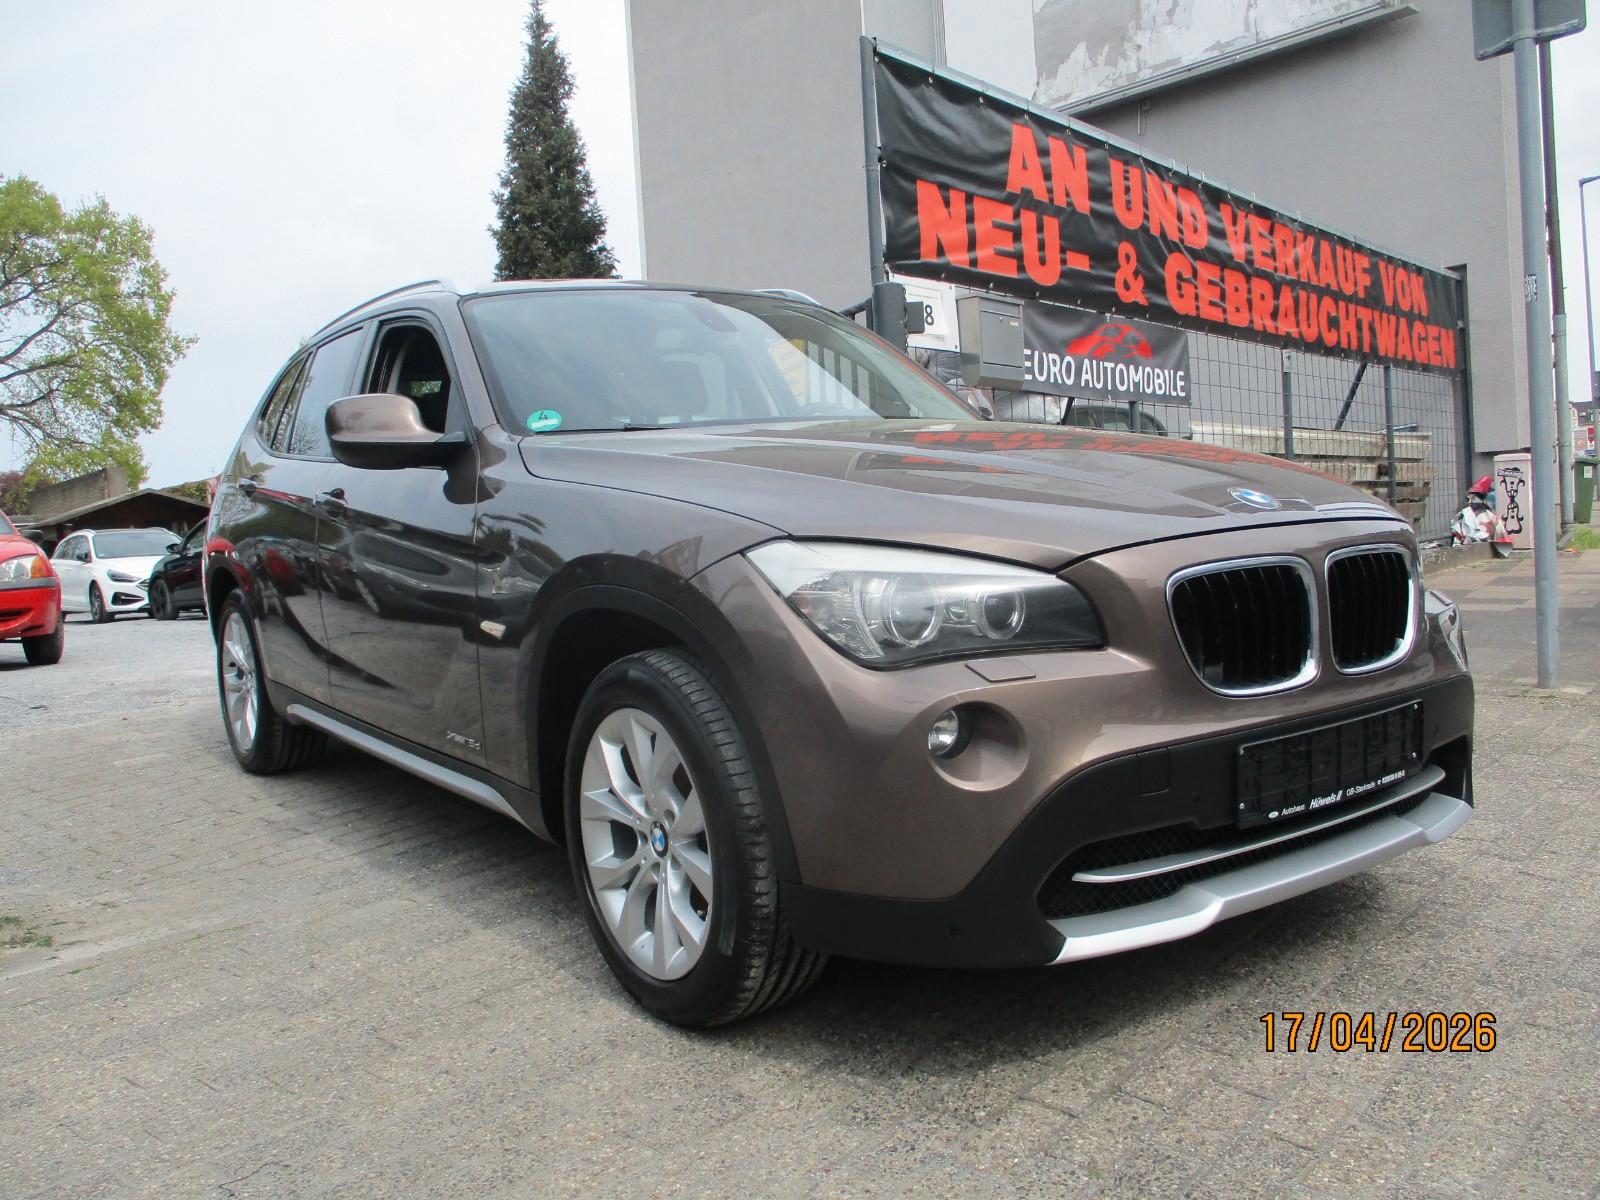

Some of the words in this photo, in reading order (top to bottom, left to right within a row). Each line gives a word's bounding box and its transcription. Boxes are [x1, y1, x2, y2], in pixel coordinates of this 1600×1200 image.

[916, 179, 1091, 286] NEU-
[1115, 241, 1148, 305] &
[1164, 251, 1456, 369] GEBRAUCHTWAGEN
[1006, 123, 1091, 216] AN
[1109, 158, 1208, 249] UND
[1220, 202, 1371, 298] VERKAUF
[1378, 260, 1428, 316] VON
[1024, 348, 1076, 386] EURO
[1080, 358, 1186, 396] AUTOMOBILE
[1281, 803, 1306, 816] Autohaus
